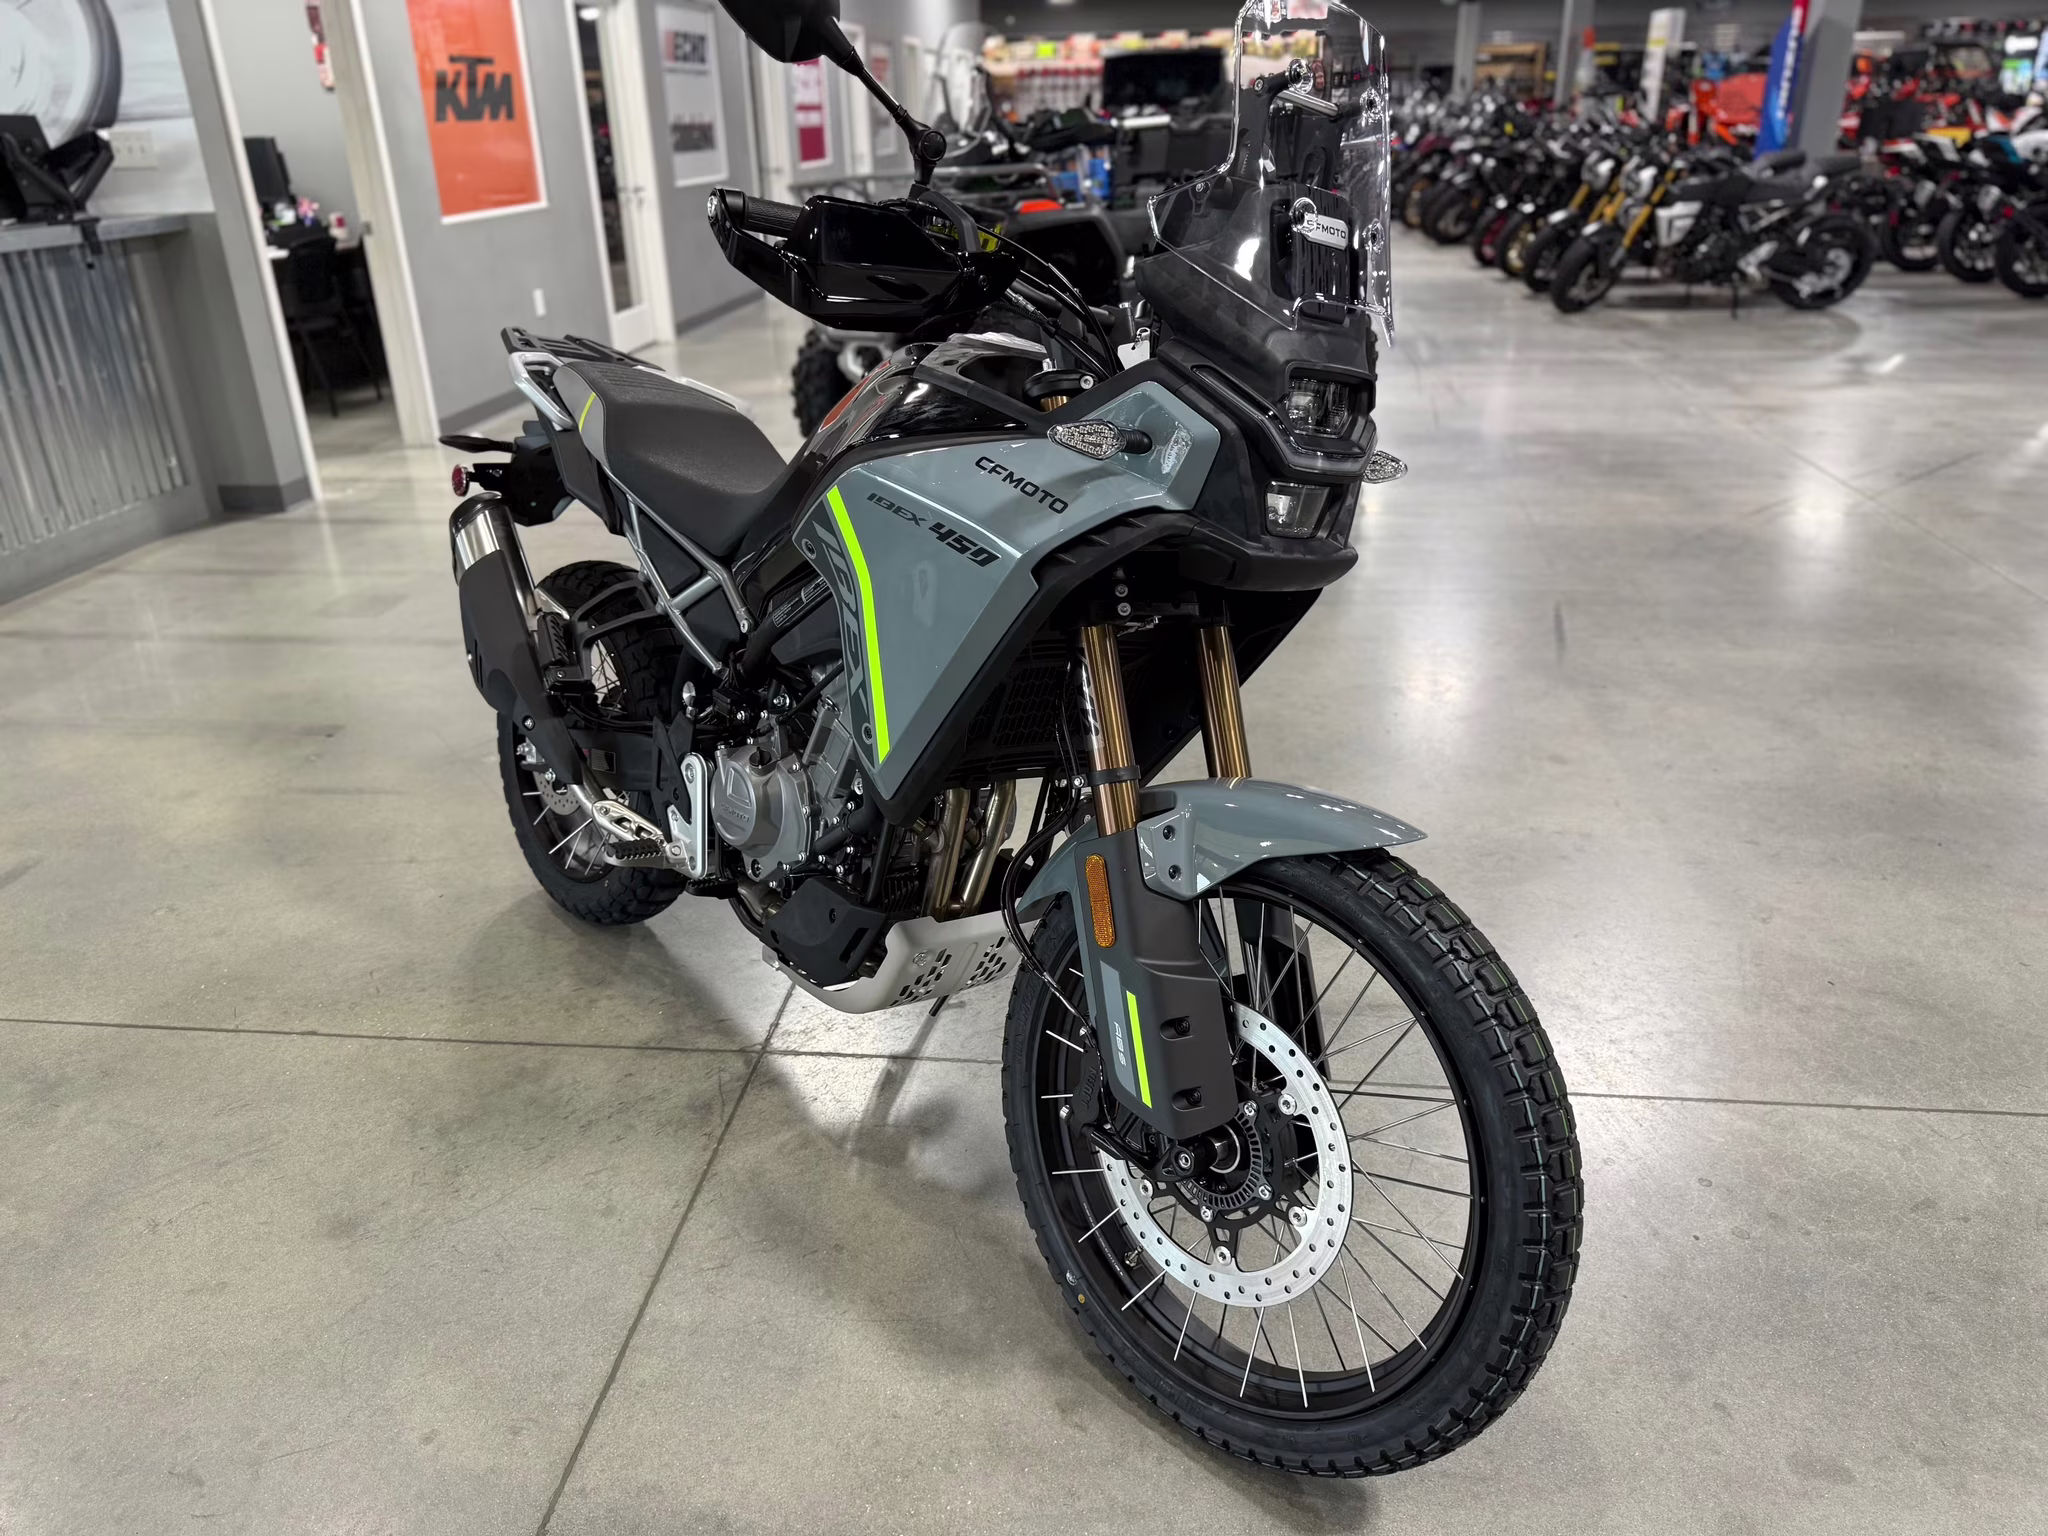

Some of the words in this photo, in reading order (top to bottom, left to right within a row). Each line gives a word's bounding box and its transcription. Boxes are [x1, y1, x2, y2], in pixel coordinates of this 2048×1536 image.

[434, 54, 515, 123] KTM
[974, 455, 1069, 515] CFMOTO
[866, 492, 928, 530] IBEX
[927, 521, 1002, 568] 450
[1113, 1021, 1127, 1067] ABS
